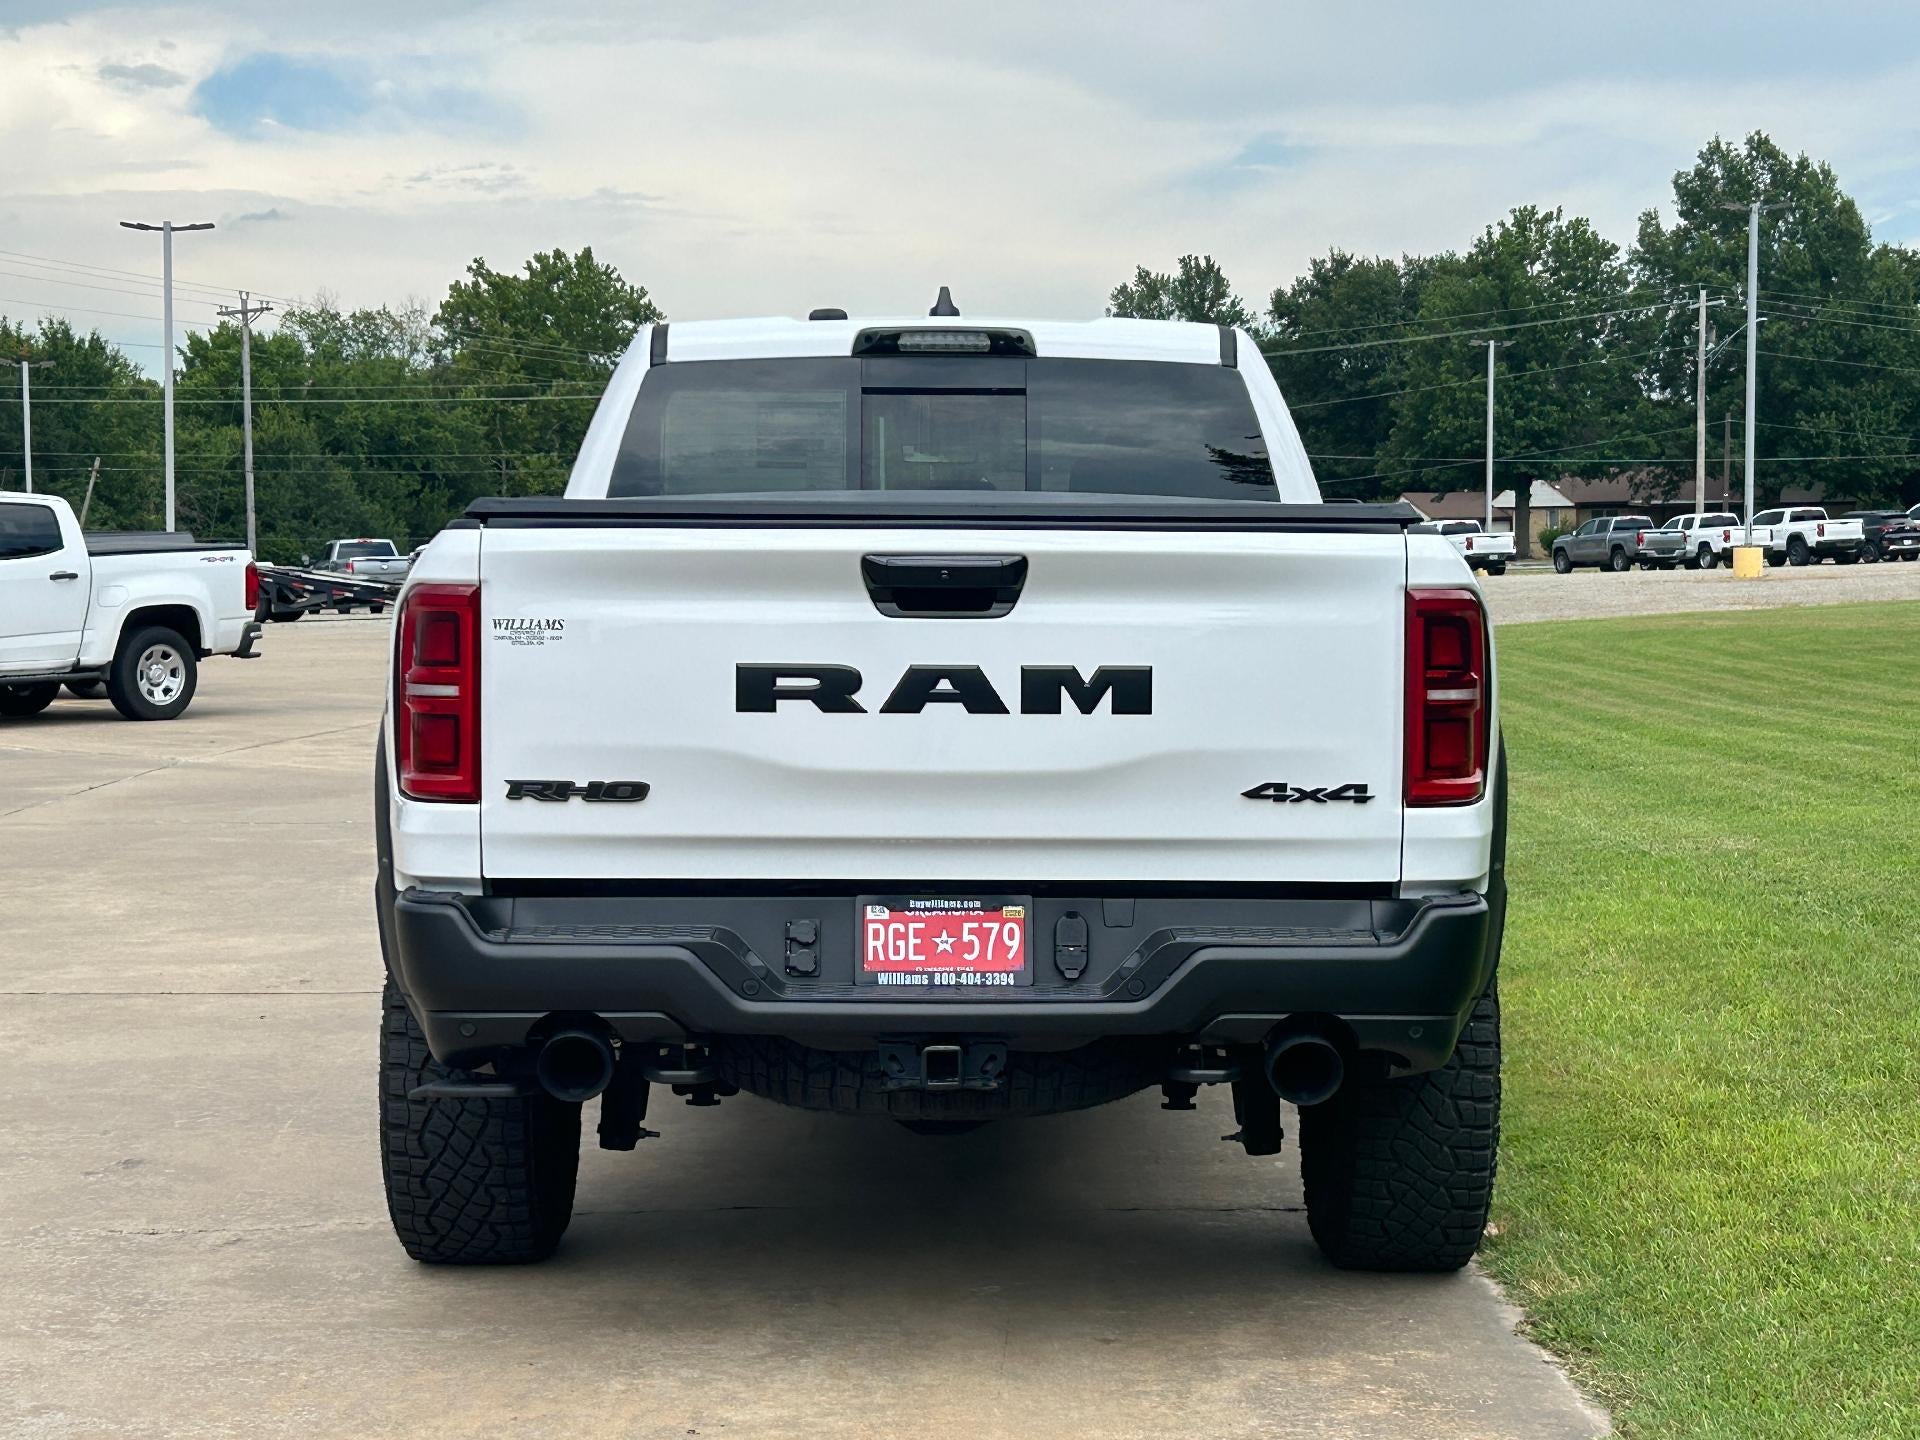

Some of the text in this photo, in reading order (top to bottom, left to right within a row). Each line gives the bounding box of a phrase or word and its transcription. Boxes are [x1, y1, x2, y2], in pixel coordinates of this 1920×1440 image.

[492, 618, 565, 631] WILLIAMS
[735, 663, 1153, 715] RAM
[867, 922, 1021, 961] RGE 579
[877, 972, 929, 985] Williams
